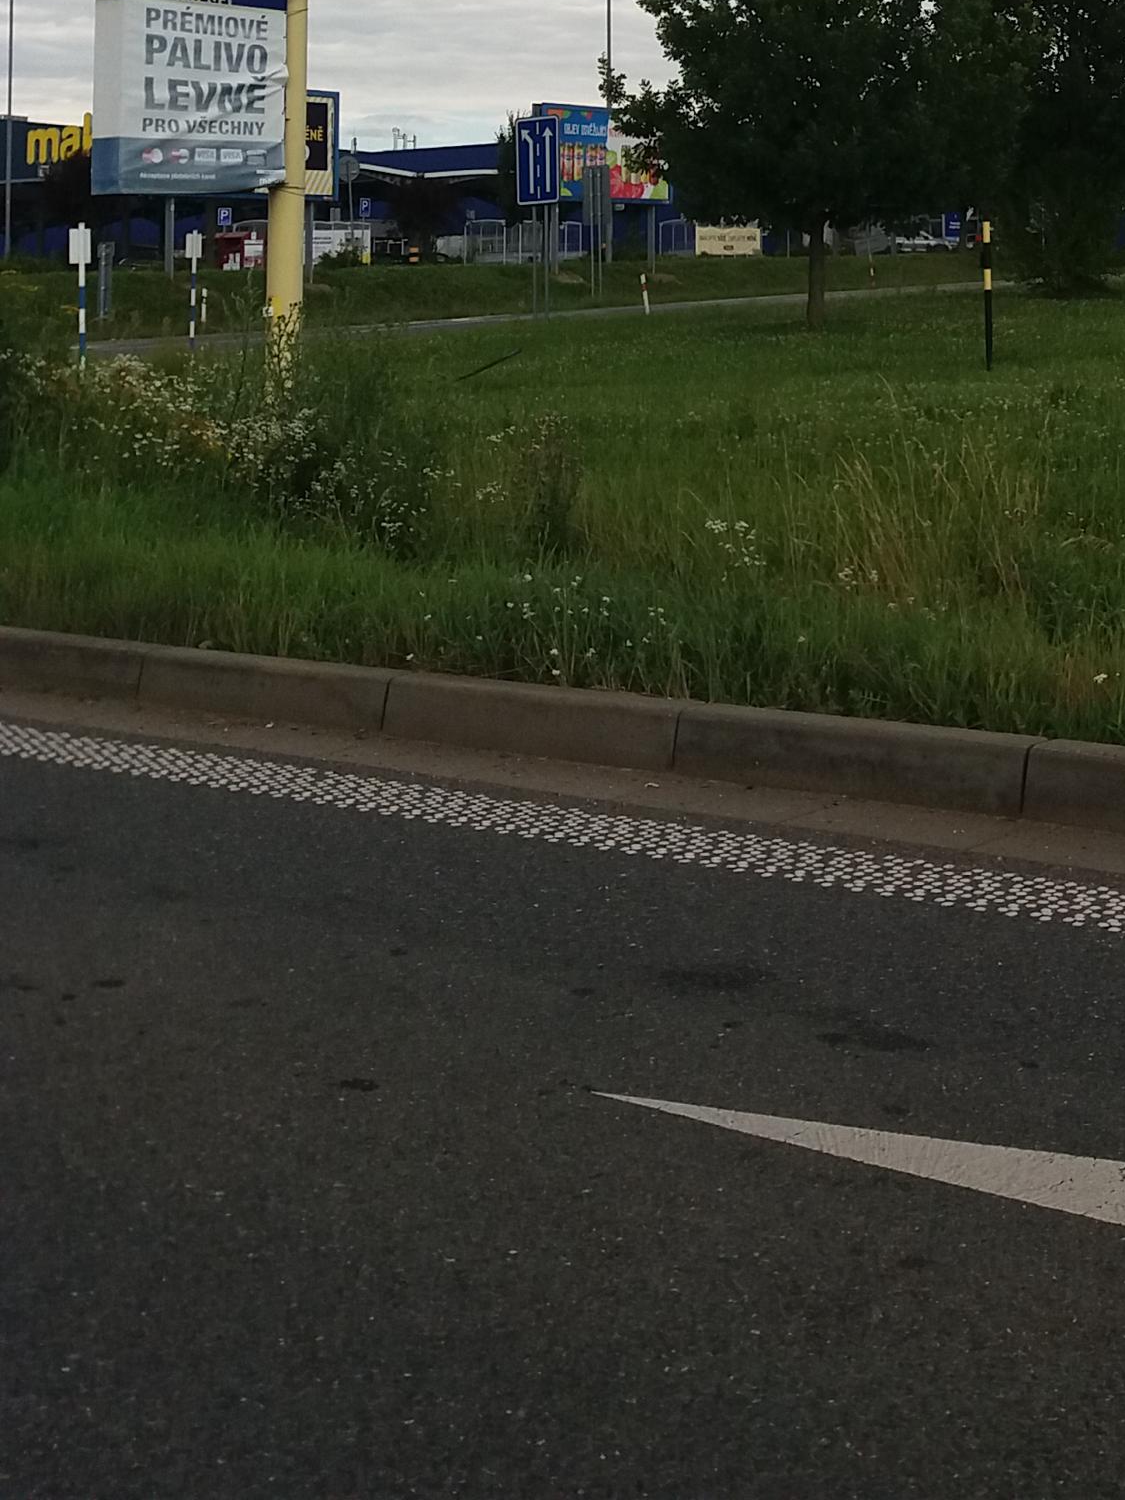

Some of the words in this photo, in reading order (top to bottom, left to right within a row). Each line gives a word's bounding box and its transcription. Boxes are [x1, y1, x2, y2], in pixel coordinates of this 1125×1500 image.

[145, 6, 269, 41] PRÉMIOVÉ
[145, 33, 269, 74] PALIVO
[144, 75, 268, 115] LEVNĚ
[142, 117, 179, 133] PRO
[185, 116, 266, 136] VŠECHNY
[220, 210, 229, 221] P
[362, 201, 369, 213] P
